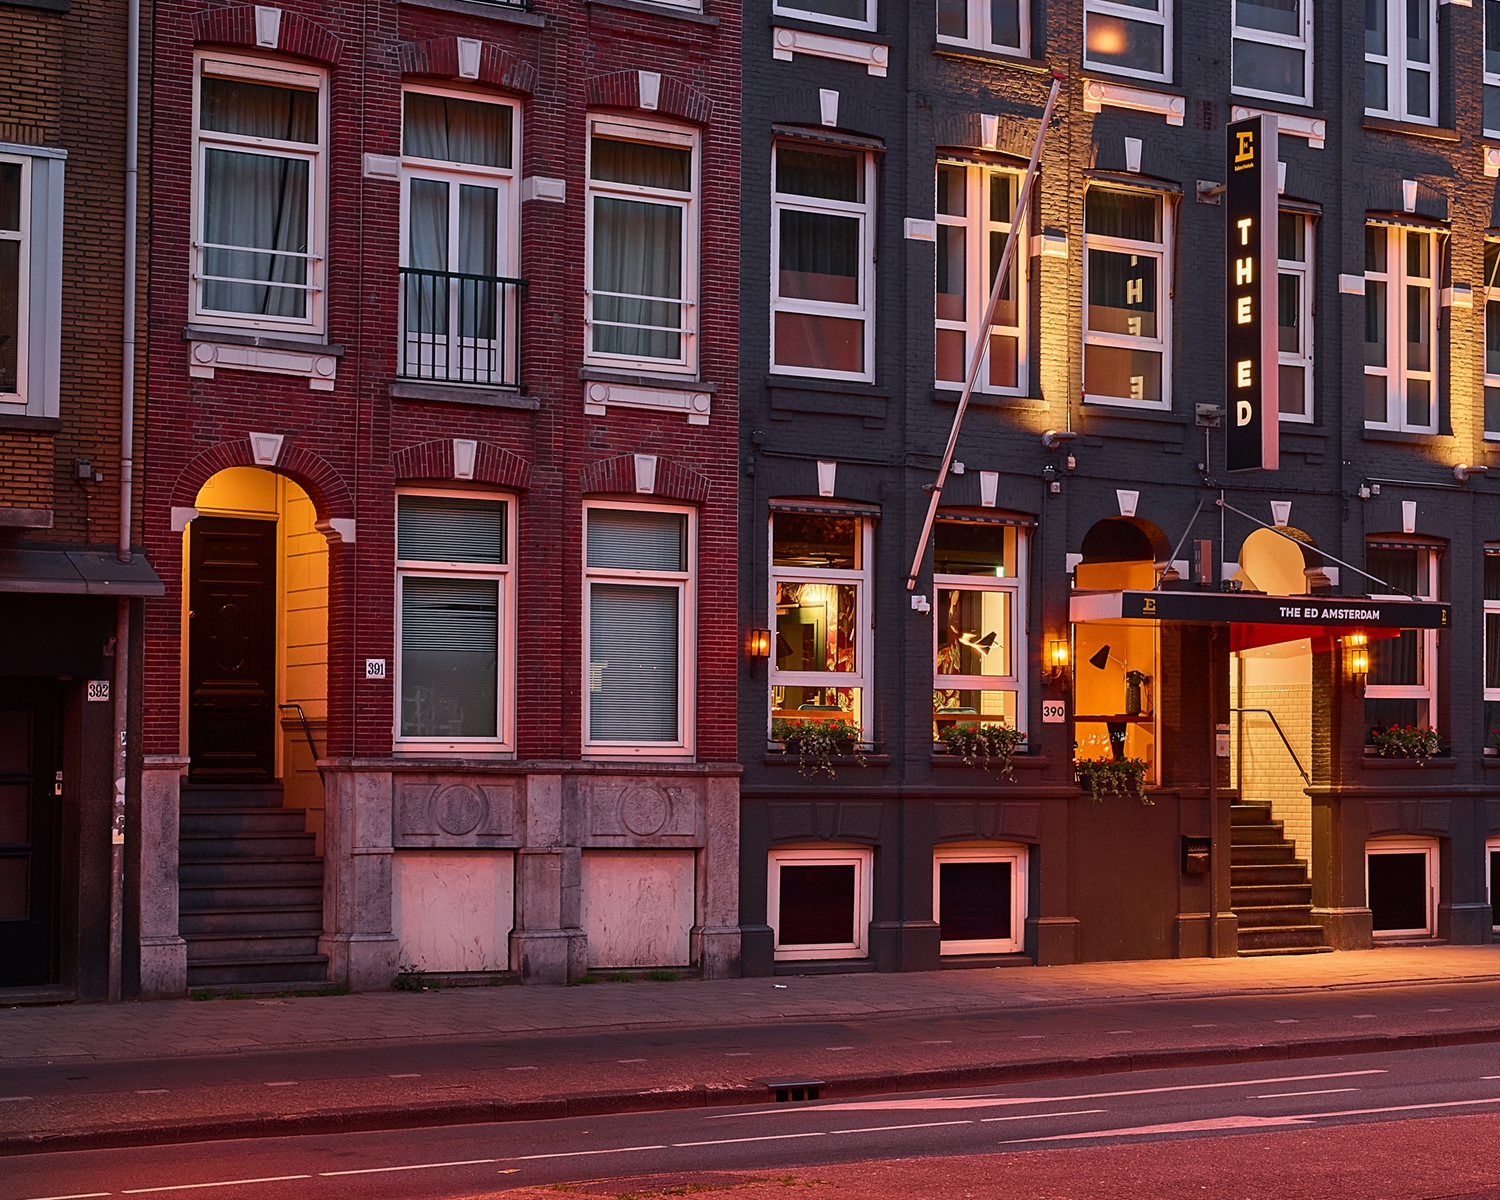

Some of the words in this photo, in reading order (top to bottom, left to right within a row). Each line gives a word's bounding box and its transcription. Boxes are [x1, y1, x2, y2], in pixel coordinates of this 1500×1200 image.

[1236, 218, 1252, 325] THE
[1236, 360, 1253, 427] ED
[1279, 607, 1301, 618] THE
[1304, 608, 1319, 618] ED
[1321, 608, 1380, 620] AMSTERDAM
[367, 662, 384, 675] 391
[88, 684, 109, 698] 392
[1043, 706, 1065, 717] 390
